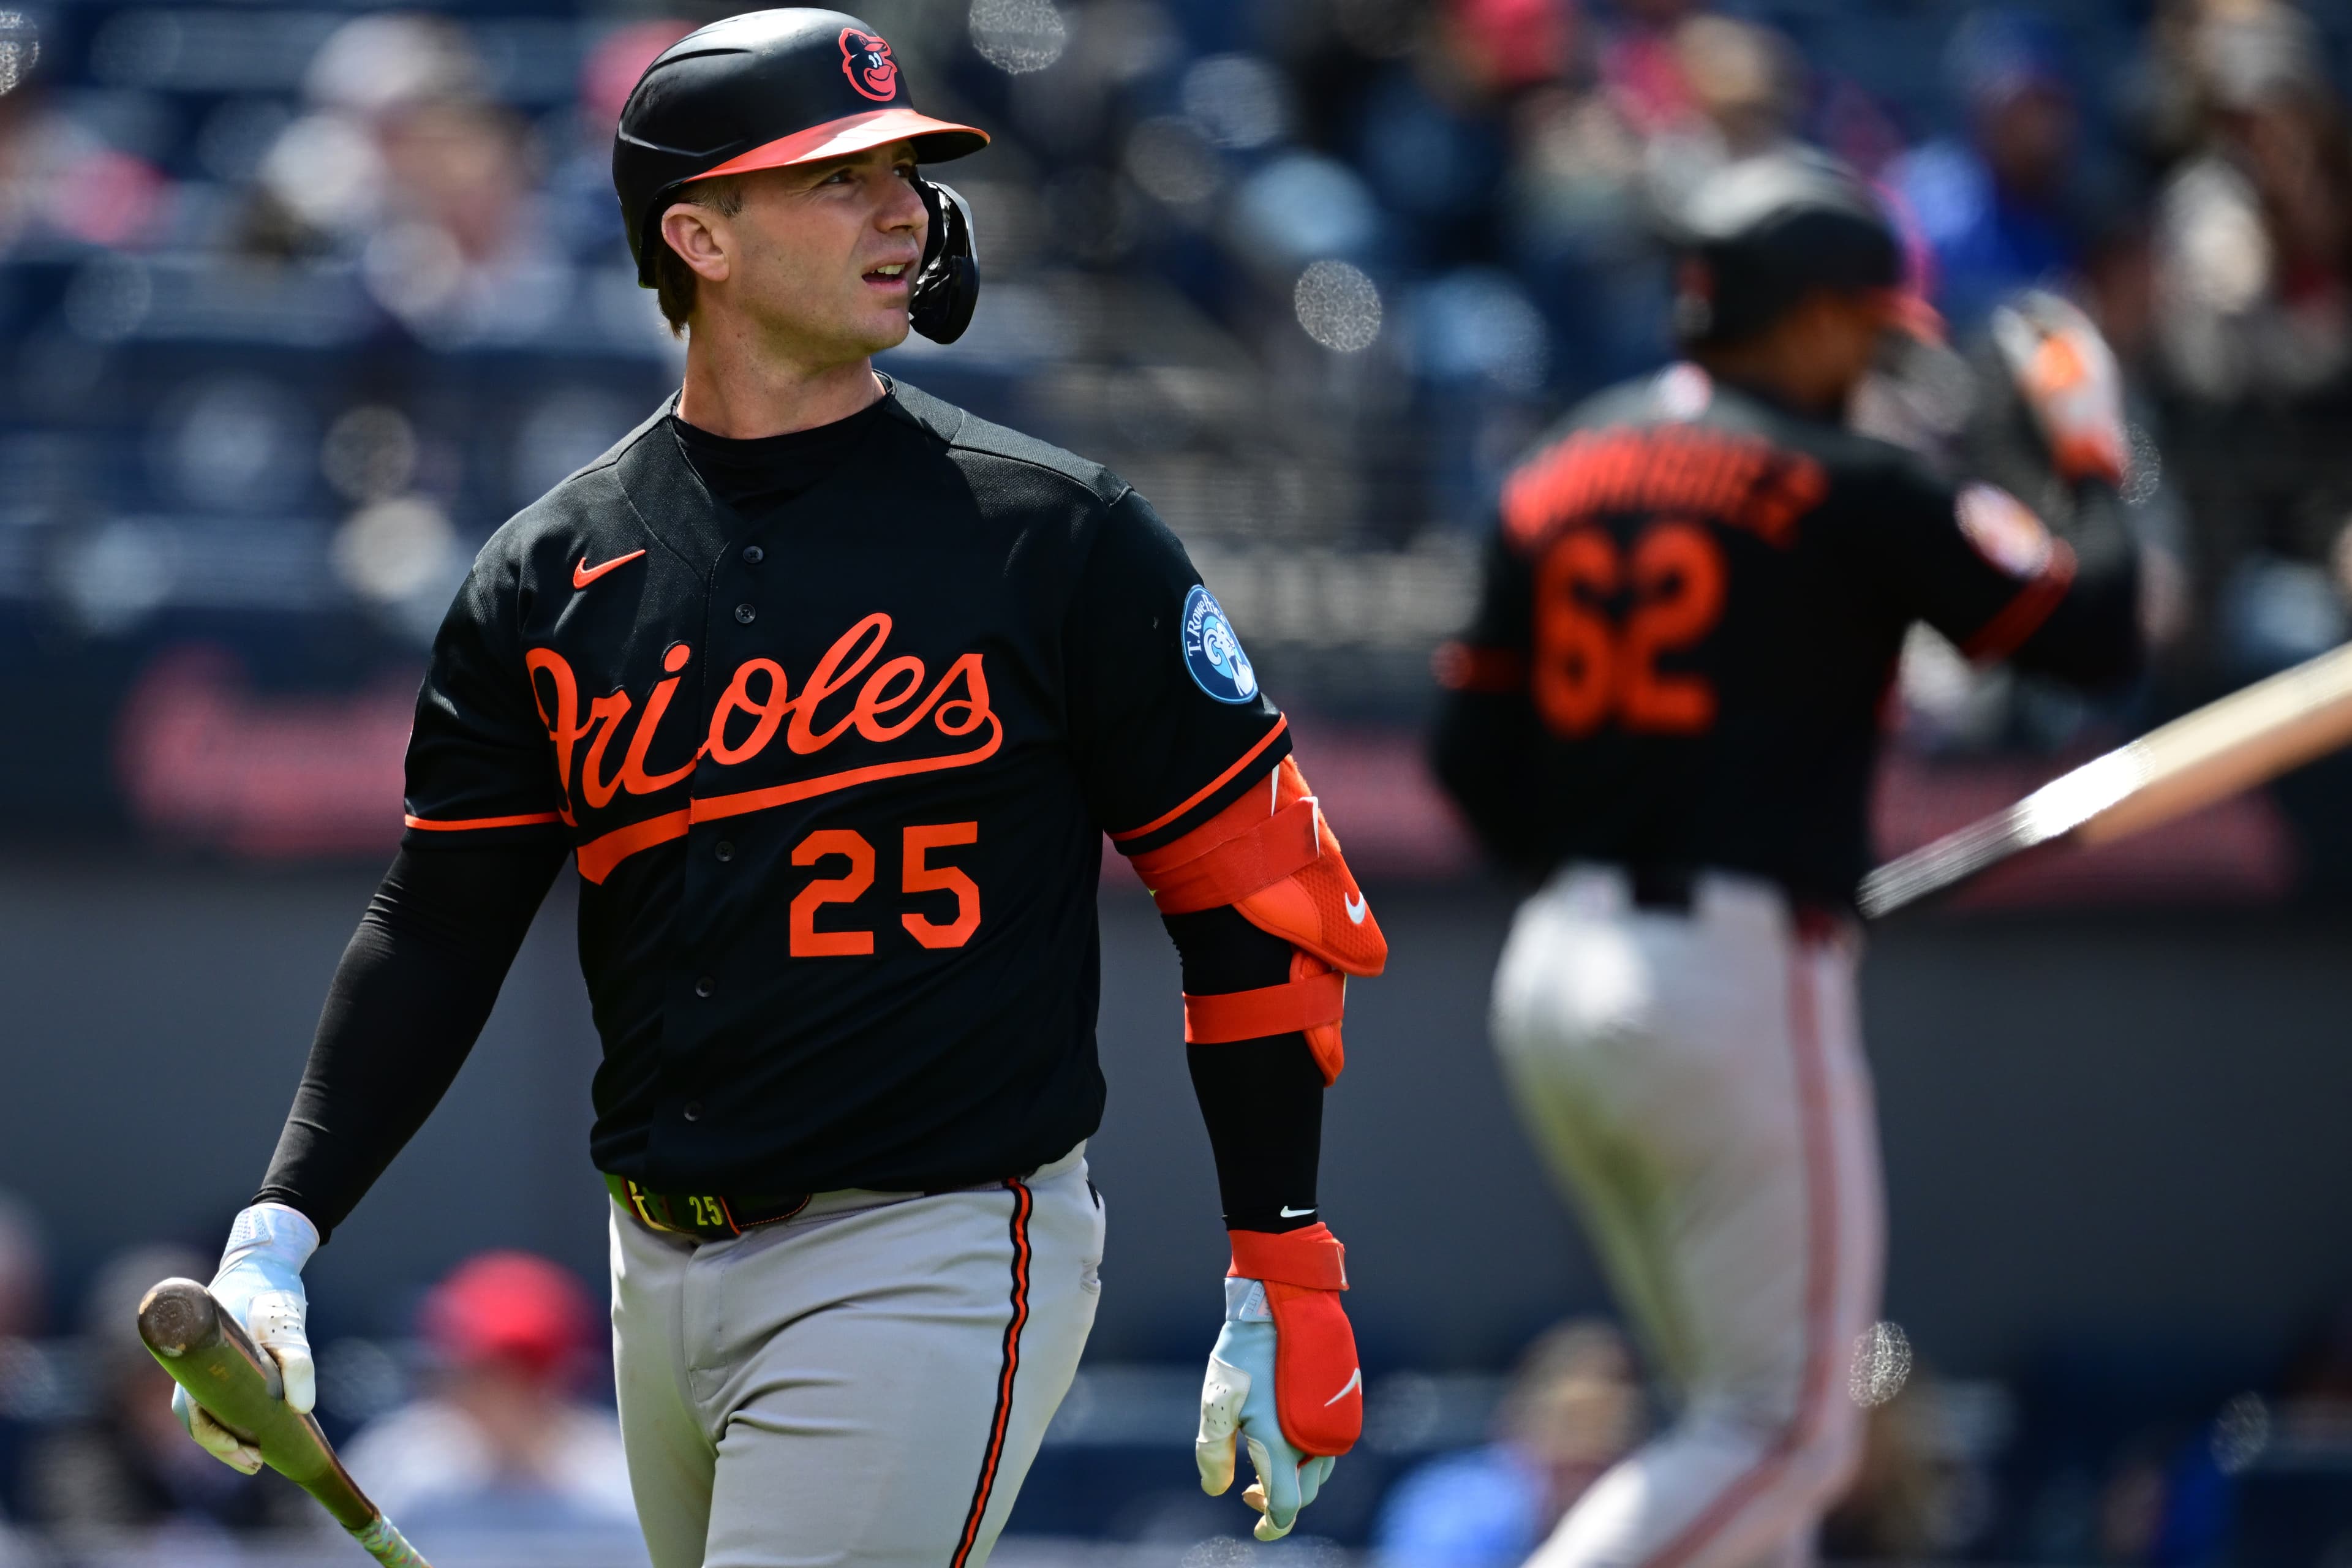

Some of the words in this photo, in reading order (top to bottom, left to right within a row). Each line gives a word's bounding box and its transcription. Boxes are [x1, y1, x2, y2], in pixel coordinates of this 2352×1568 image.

[1536, 522, 1726, 734] 62
[526, 612, 1003, 827] Orioles
[790, 821, 981, 957] 25
[689, 1196, 723, 1226] 25
